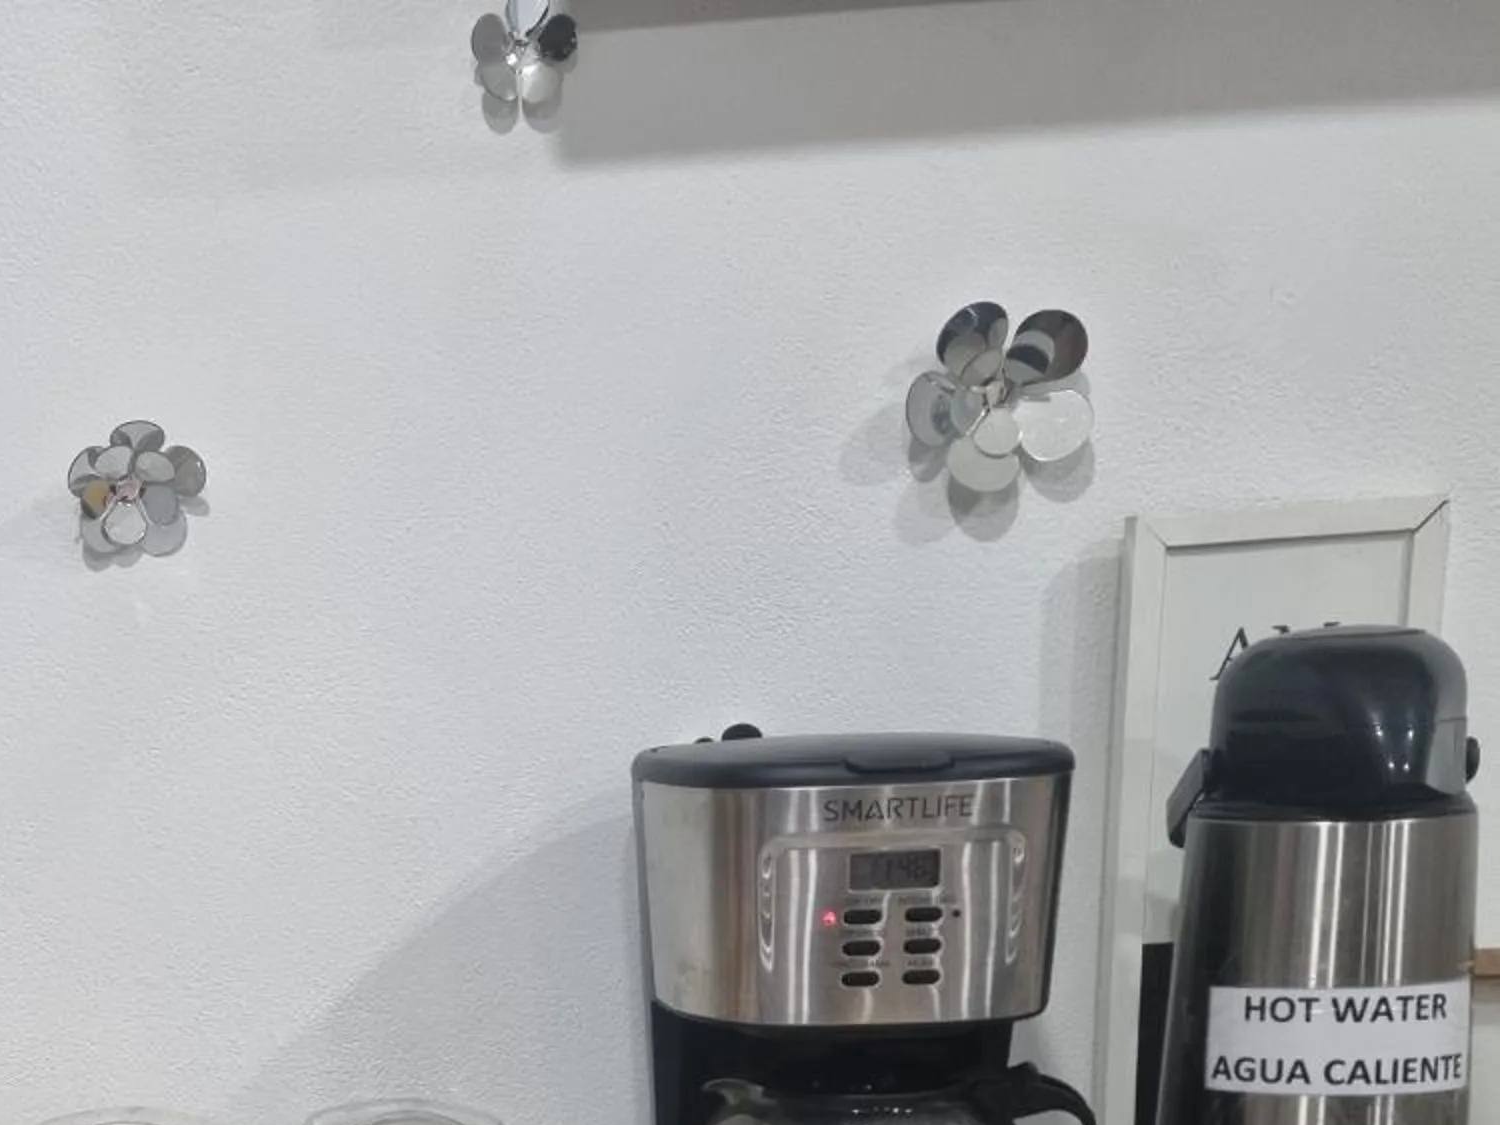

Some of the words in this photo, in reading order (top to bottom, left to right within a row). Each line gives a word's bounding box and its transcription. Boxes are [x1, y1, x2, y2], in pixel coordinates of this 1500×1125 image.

[823, 794, 973, 822] SMARTLIFE
[1244, 995, 1320, 1023] HOT
[1331, 993, 1447, 1023] WATER
[1211, 1055, 1311, 1085] AGUA
[1323, 1052, 1463, 1086] CALIENTE
